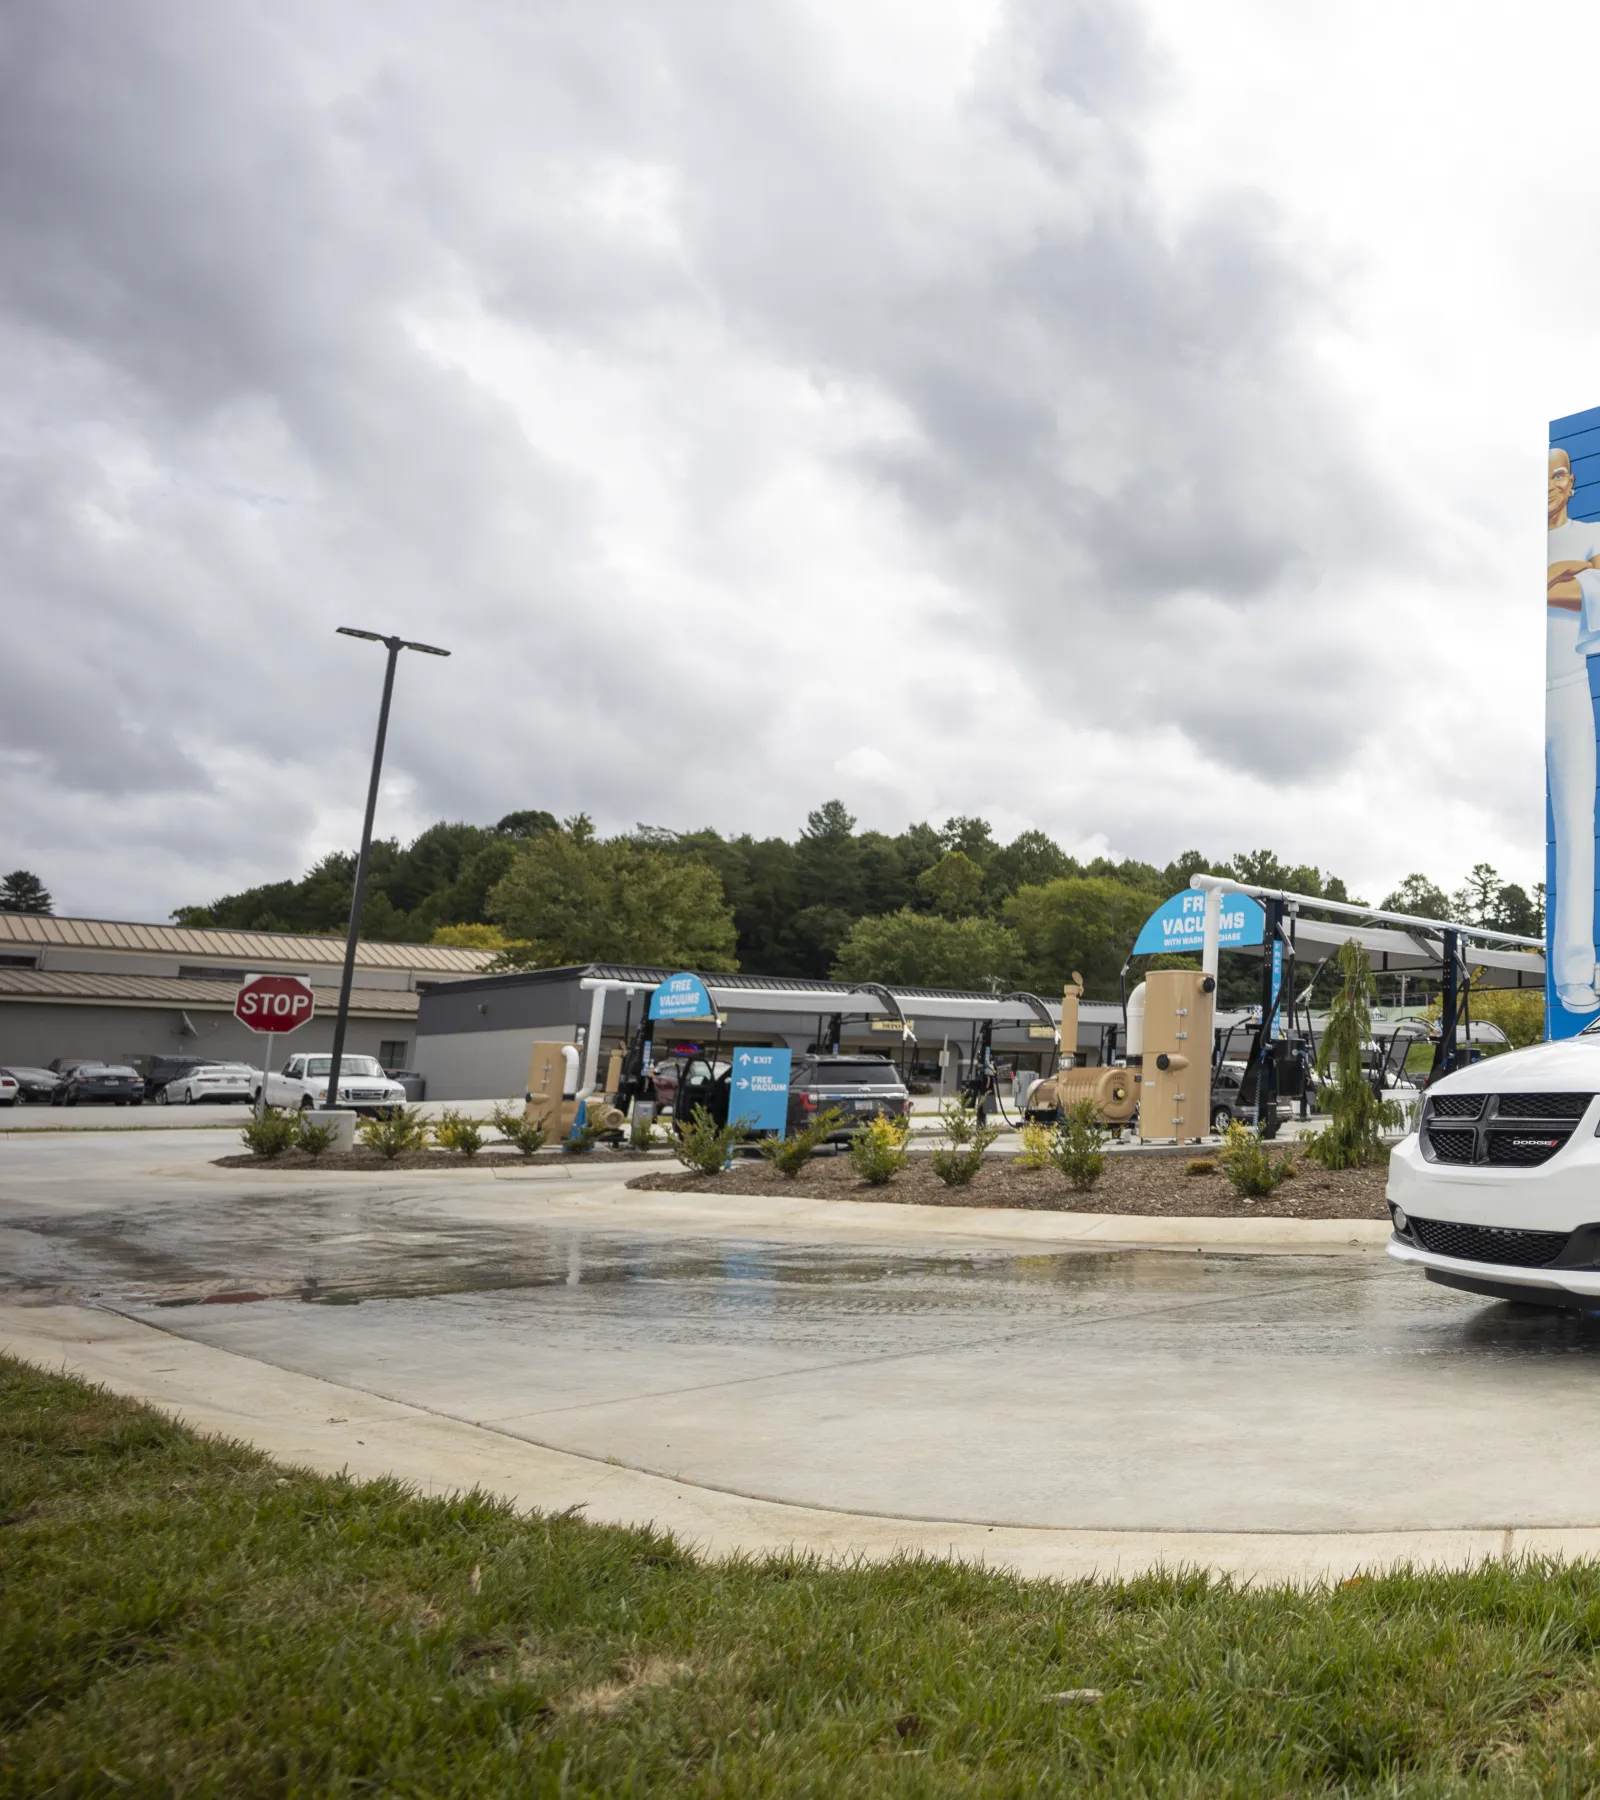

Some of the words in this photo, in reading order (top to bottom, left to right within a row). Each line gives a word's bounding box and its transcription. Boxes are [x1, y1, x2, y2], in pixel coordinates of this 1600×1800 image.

[1183, 894, 1225, 914] FRE
[1163, 912, 1244, 935] VACUMS
[1164, 937, 1181, 946] WITH
[1182, 936, 1203, 945] WASH
[671, 979, 692, 992] FREE
[241, 992, 309, 1016] STOP
[660, 992, 699, 1006] VACUUMS
[753, 1055, 773, 1064] EXIT
[751, 1076, 773, 1085] FREE
[751, 1083, 787, 1091] VACUUM
